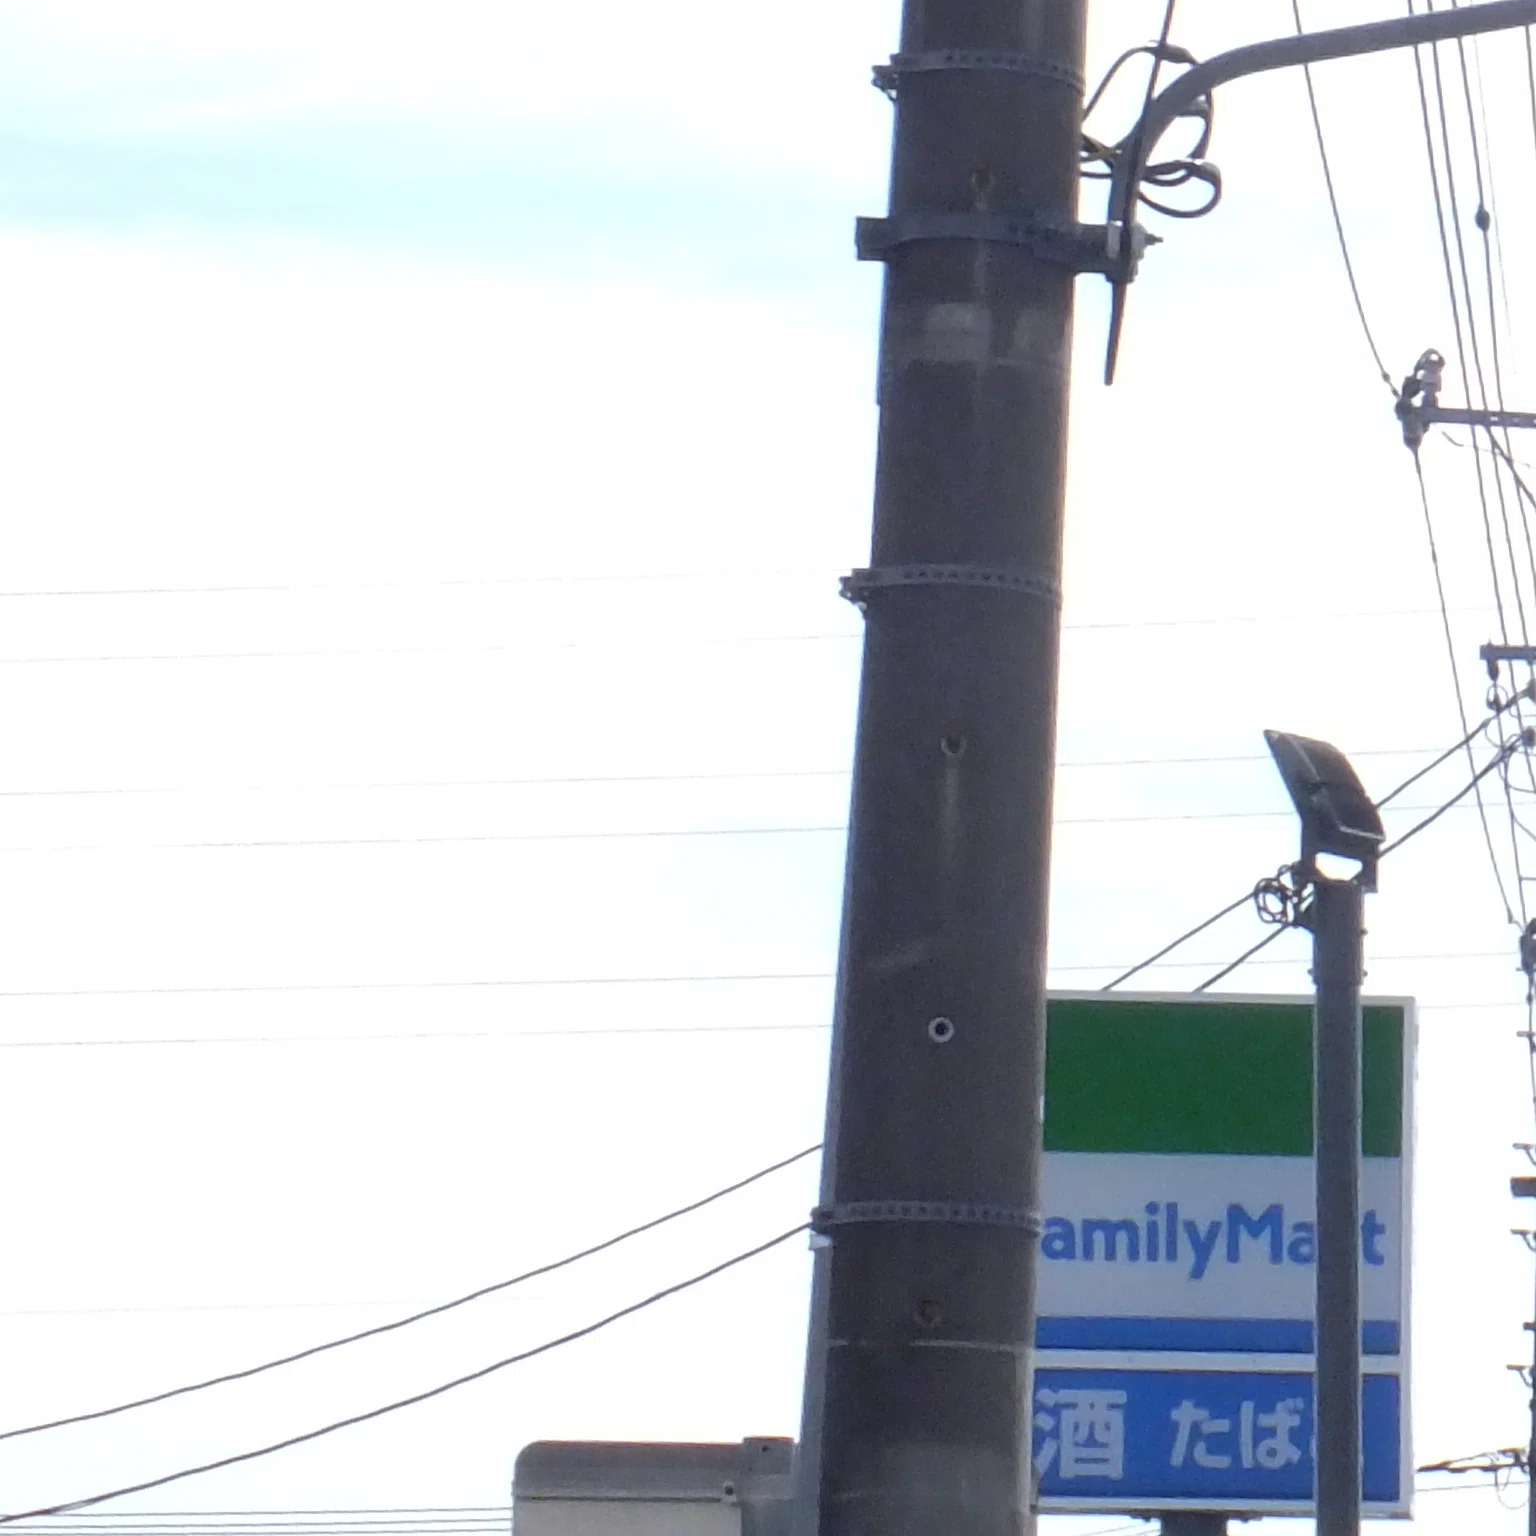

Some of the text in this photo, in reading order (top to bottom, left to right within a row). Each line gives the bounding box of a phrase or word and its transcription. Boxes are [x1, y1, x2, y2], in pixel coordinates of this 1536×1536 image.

[1041, 1201, 1385, 1279] amilyMat
[1034, 1388, 1363, 1479] 酒 たば
